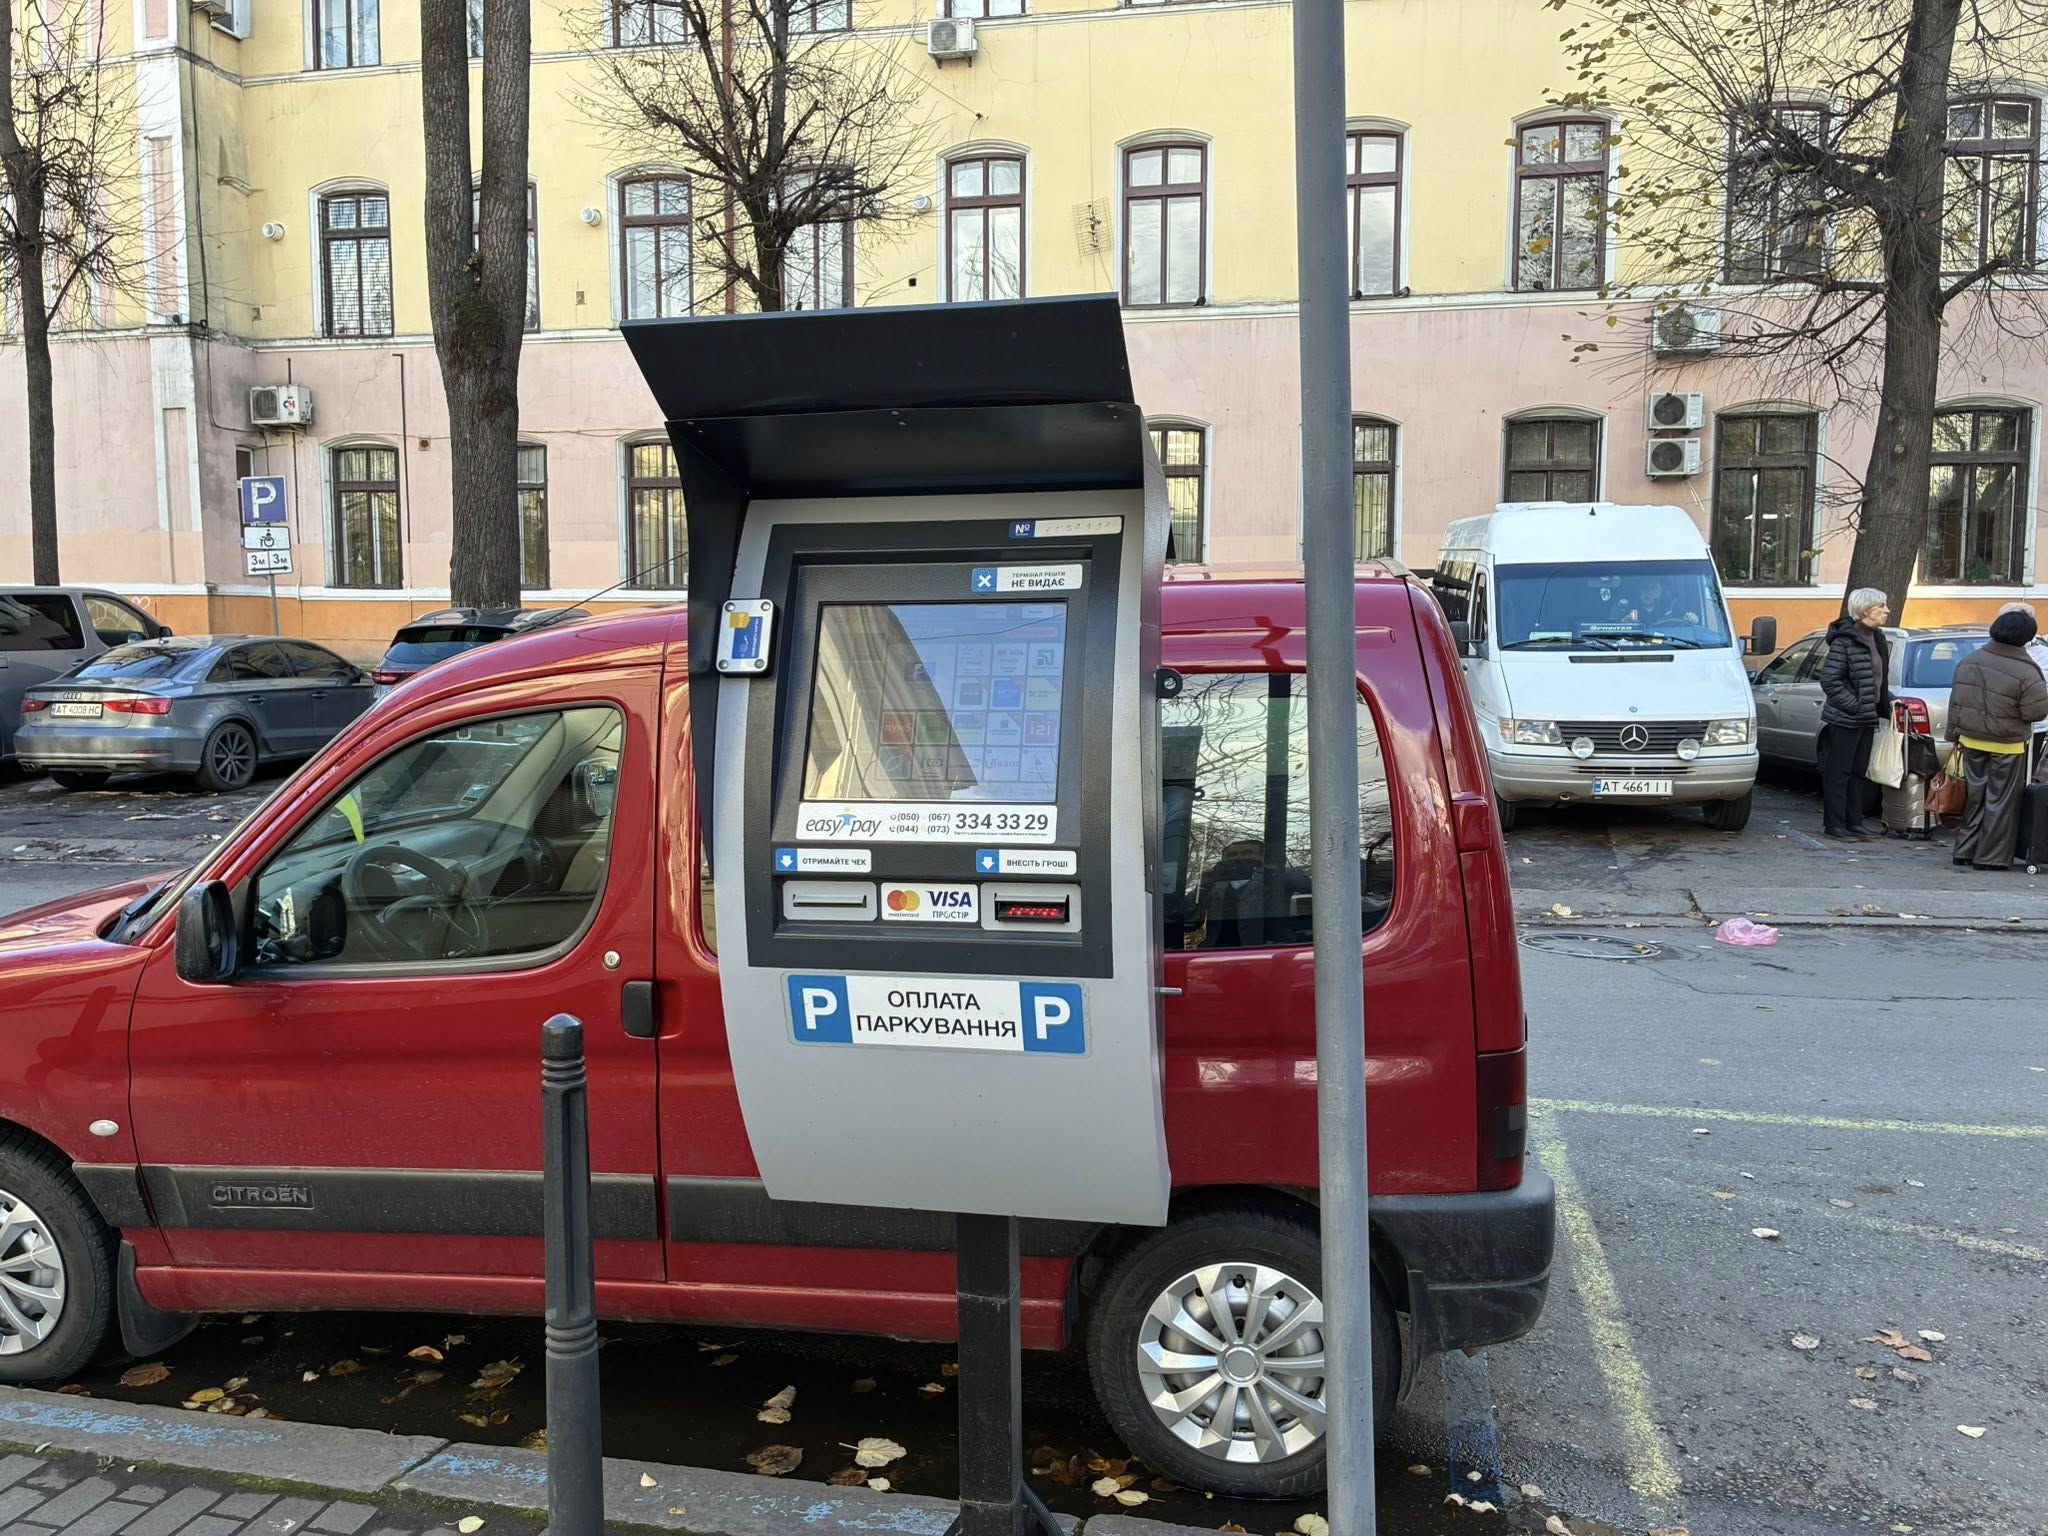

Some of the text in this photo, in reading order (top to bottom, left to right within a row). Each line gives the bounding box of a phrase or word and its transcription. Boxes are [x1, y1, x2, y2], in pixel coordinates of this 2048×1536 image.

[251, 481, 277, 518] P
[251, 553, 287, 565] 3м 3м
[1012, 570, 1066, 579] ТЕРМІНАЛ РЕШТИ
[1011, 578, 1065, 588] НЕ ВИДАЄ
[56, 705, 68, 714] AT
[1602, 781, 1668, 792] AT 4661 II
[897, 812, 951, 822] (050) (067)
[955, 812, 1049, 831] 334 33 29
[806, 818, 882, 837] easy pay
[896, 824, 950, 834] (044) (073)
[802, 856, 867, 866] ОТРИМАЙТЕ ЧЕК
[1006, 858, 1069, 868] ВНЕСІТЬ ГРОШІ
[926, 890, 972, 908] VISA
[932, 910, 969, 921] ПРОСТІР
[887, 990, 981, 1011] ОПЛАТА
[802, 987, 838, 1030] P
[1034, 995, 1071, 1040] P
[857, 1015, 1017, 1038] ПАРКУВАННЯ
[213, 1184, 308, 1203] CITROËN
